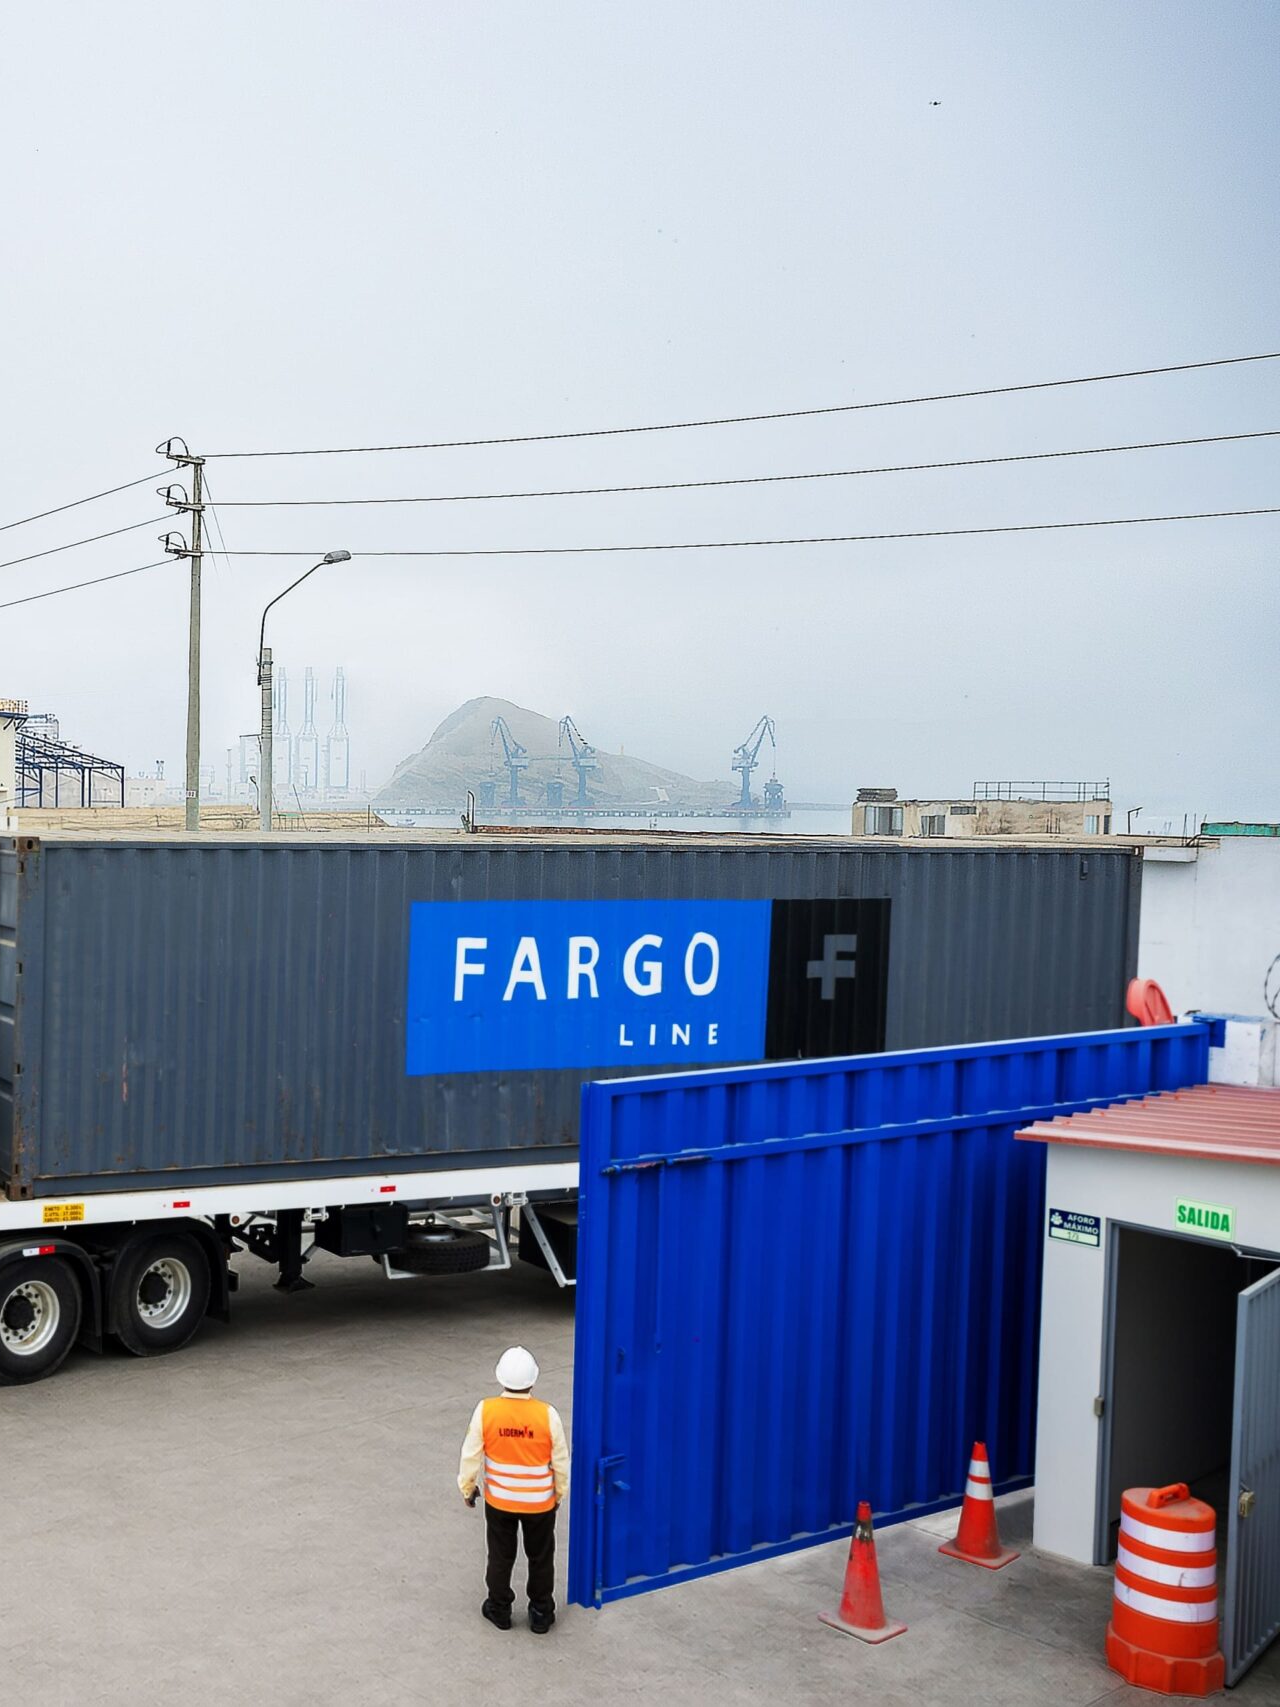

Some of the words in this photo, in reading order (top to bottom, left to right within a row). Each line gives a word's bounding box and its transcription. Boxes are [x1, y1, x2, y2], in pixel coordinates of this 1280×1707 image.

[454, 931, 720, 1001] FARGO
[619, 1023, 719, 1047] LINE
[1063, 1220, 1099, 1235] MÁXIMO
[1067, 1214, 1095, 1226] AFORO
[1178, 1204, 1230, 1233] SALIDA
